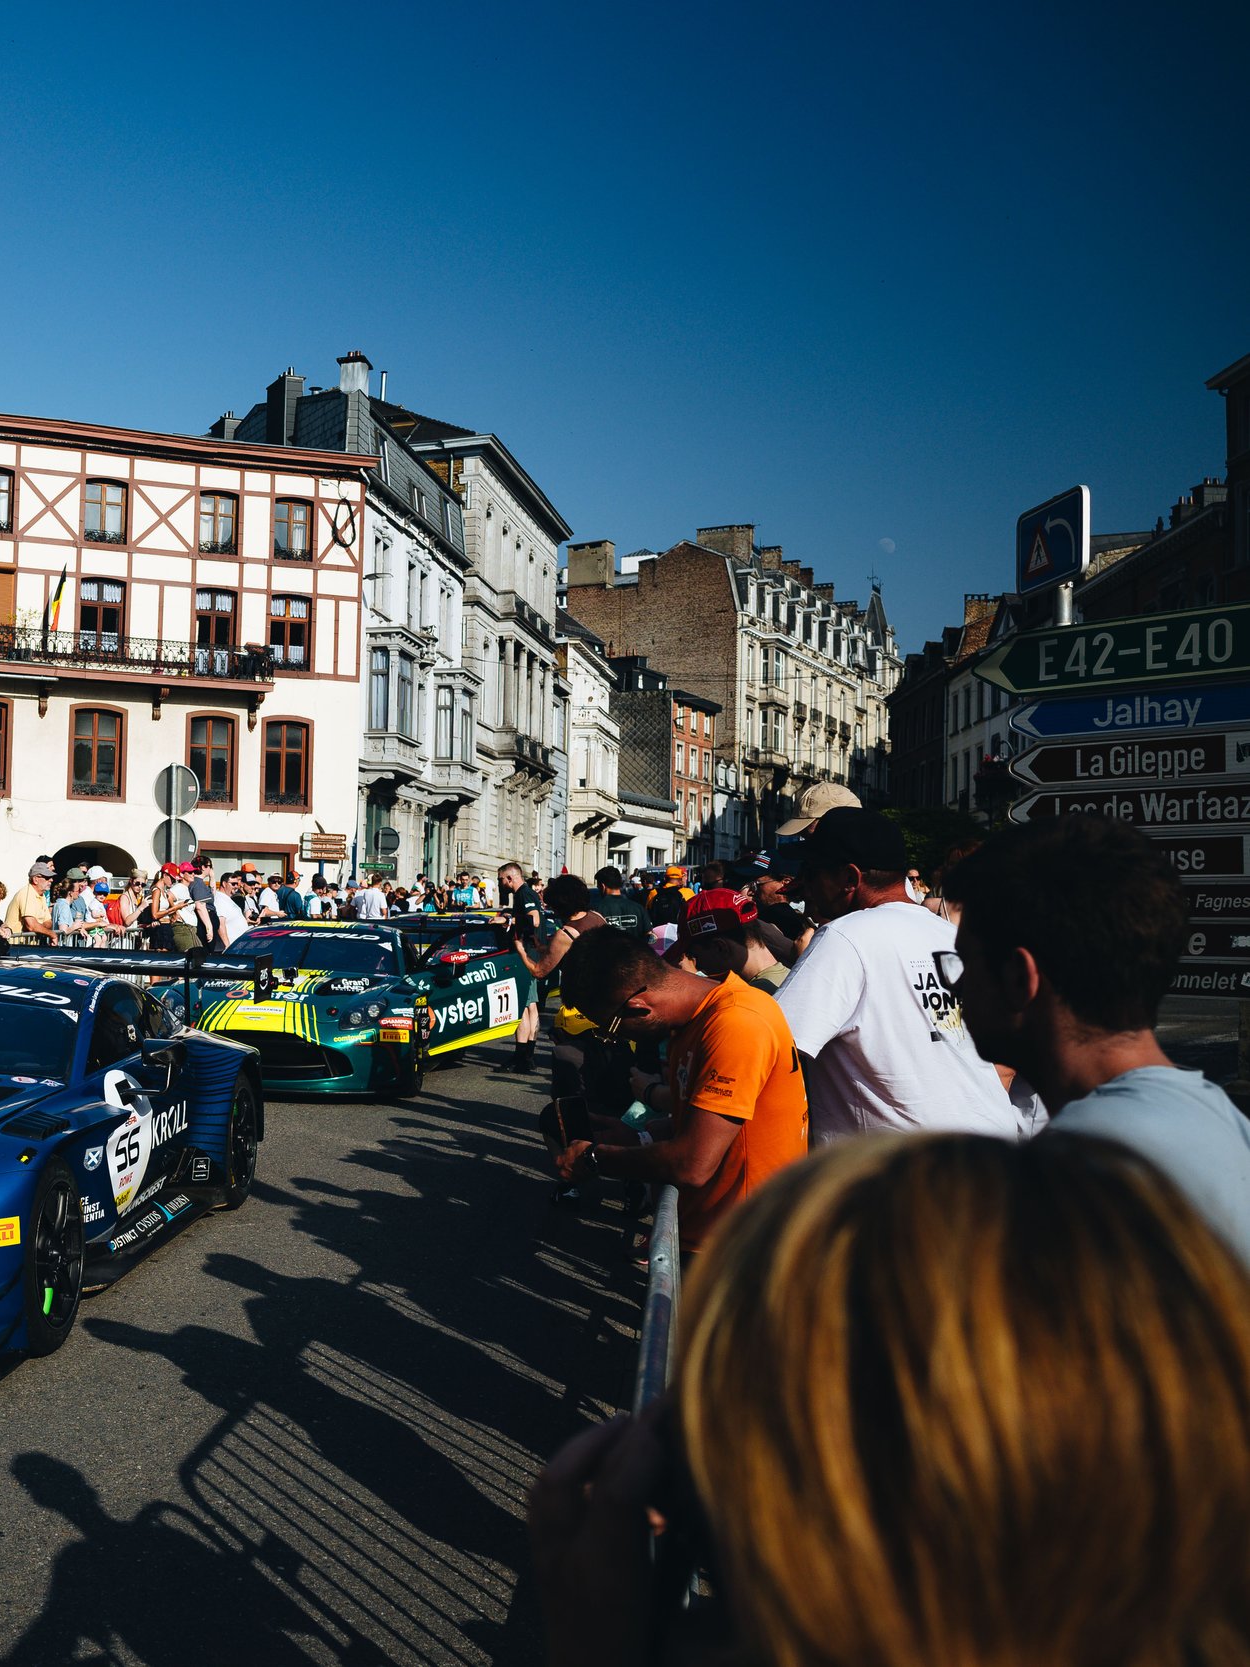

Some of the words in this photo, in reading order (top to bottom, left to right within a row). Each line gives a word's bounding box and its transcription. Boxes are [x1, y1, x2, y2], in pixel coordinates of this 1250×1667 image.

[1092, 695, 1203, 728] Jalhay
[1075, 748, 1104, 777] La
[1109, 744, 1206, 780] Gileppe
[1103, 795, 1134, 822] de
[1195, 893, 1250, 912] Fagnes
[497, 993, 509, 1014] 11
[493, 1014, 512, 1024] ROWE
[382, 1031, 407, 1040] PIRELLI
[152, 1100, 188, 1150] KROLL
[114, 1125, 141, 1173] 56
[110, 1228, 139, 1250] DISTINCT
